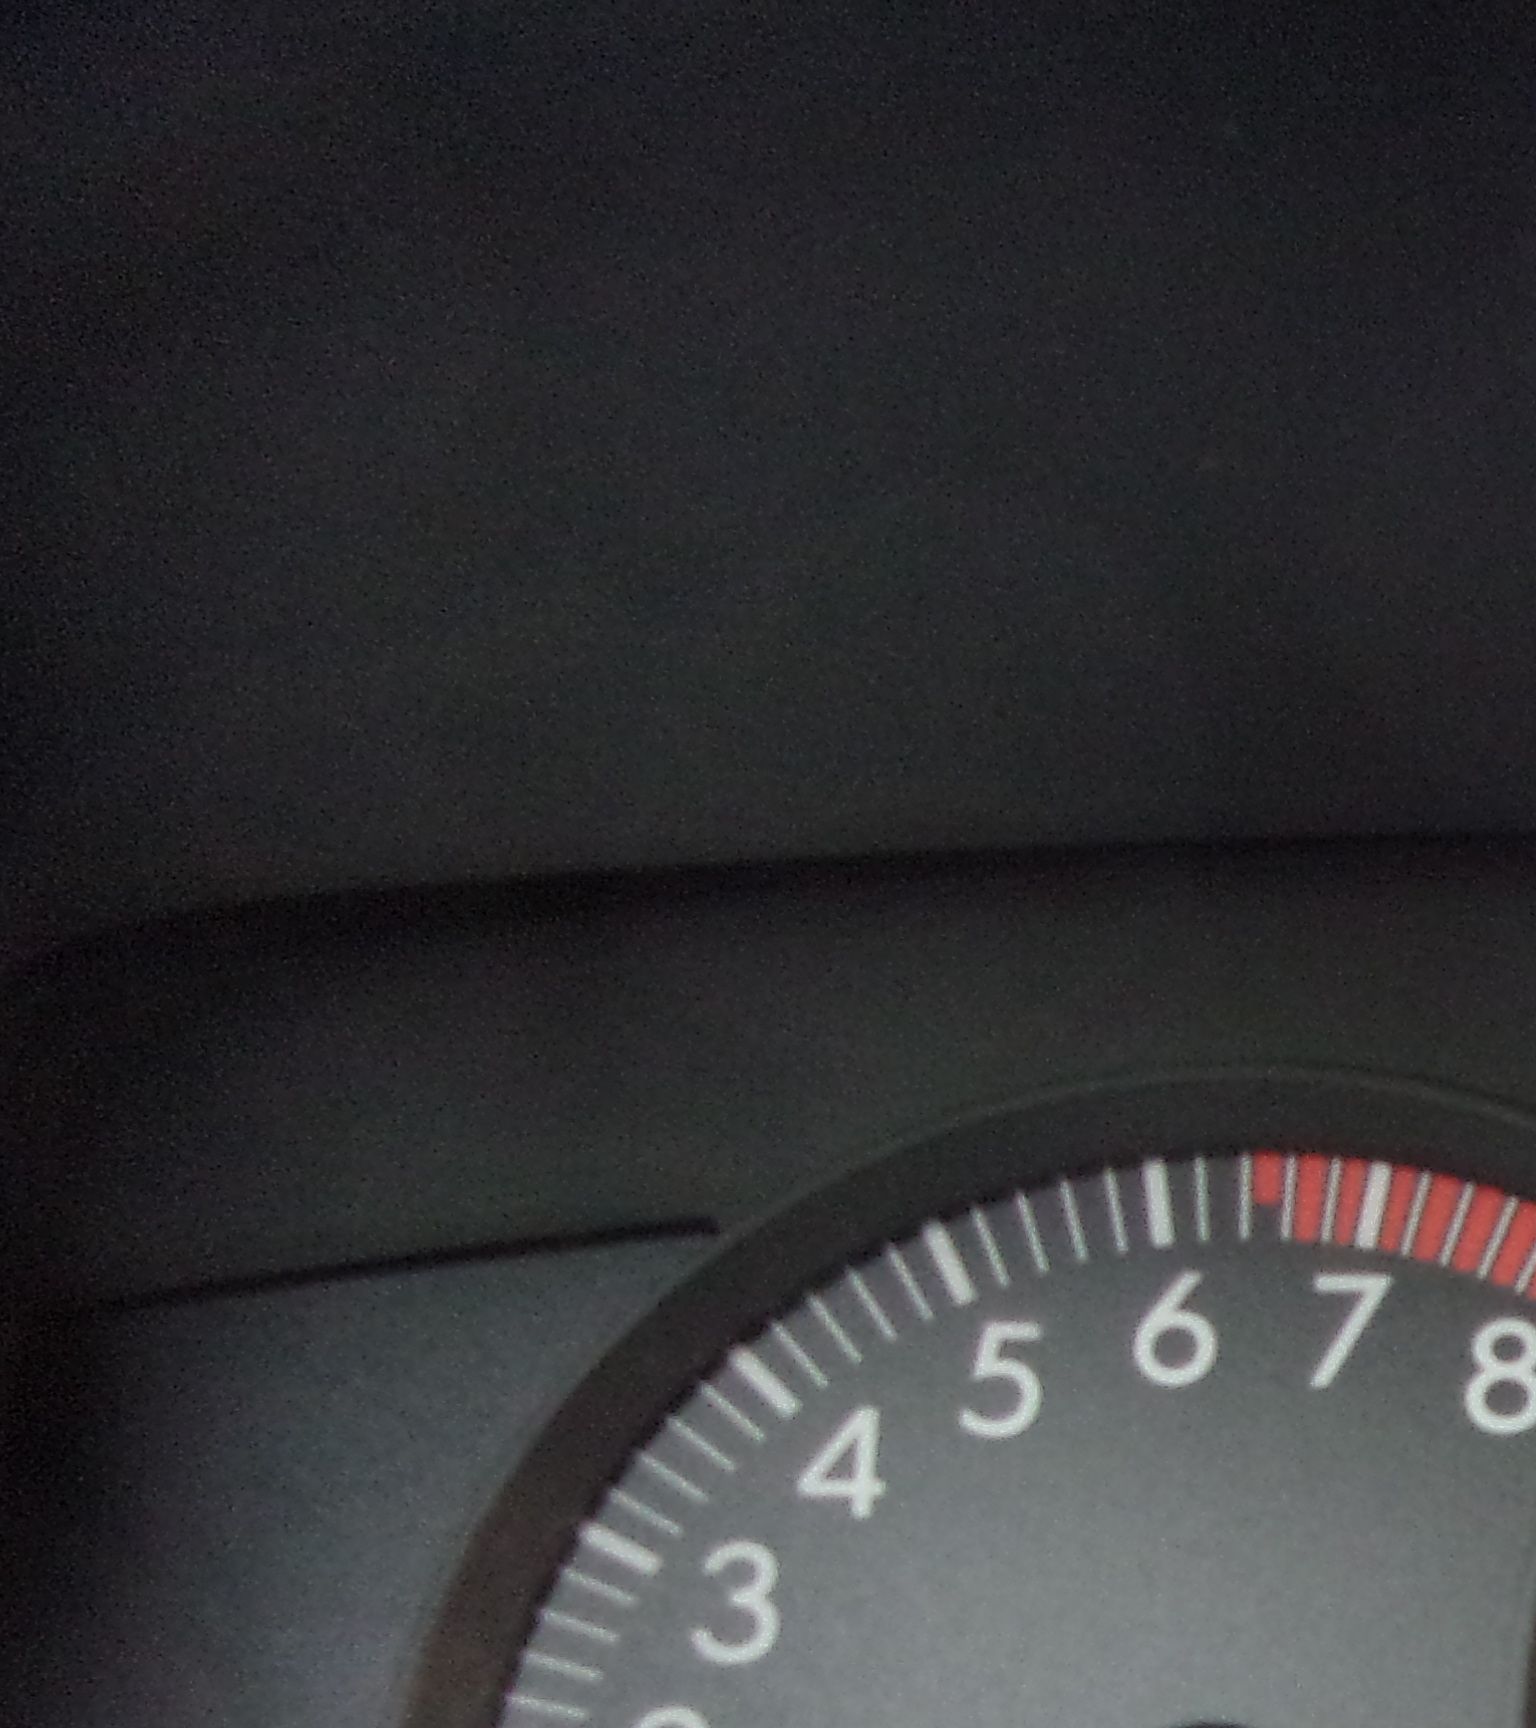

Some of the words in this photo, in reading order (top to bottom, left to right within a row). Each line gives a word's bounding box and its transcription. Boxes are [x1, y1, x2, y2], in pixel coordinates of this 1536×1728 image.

[959, 1321, 1041, 1439] 5
[1132, 1272, 1217, 1388] 6
[1310, 1273, 1391, 1389] 7
[797, 1407, 885, 1519] 4
[691, 1540, 779, 1665] 3
